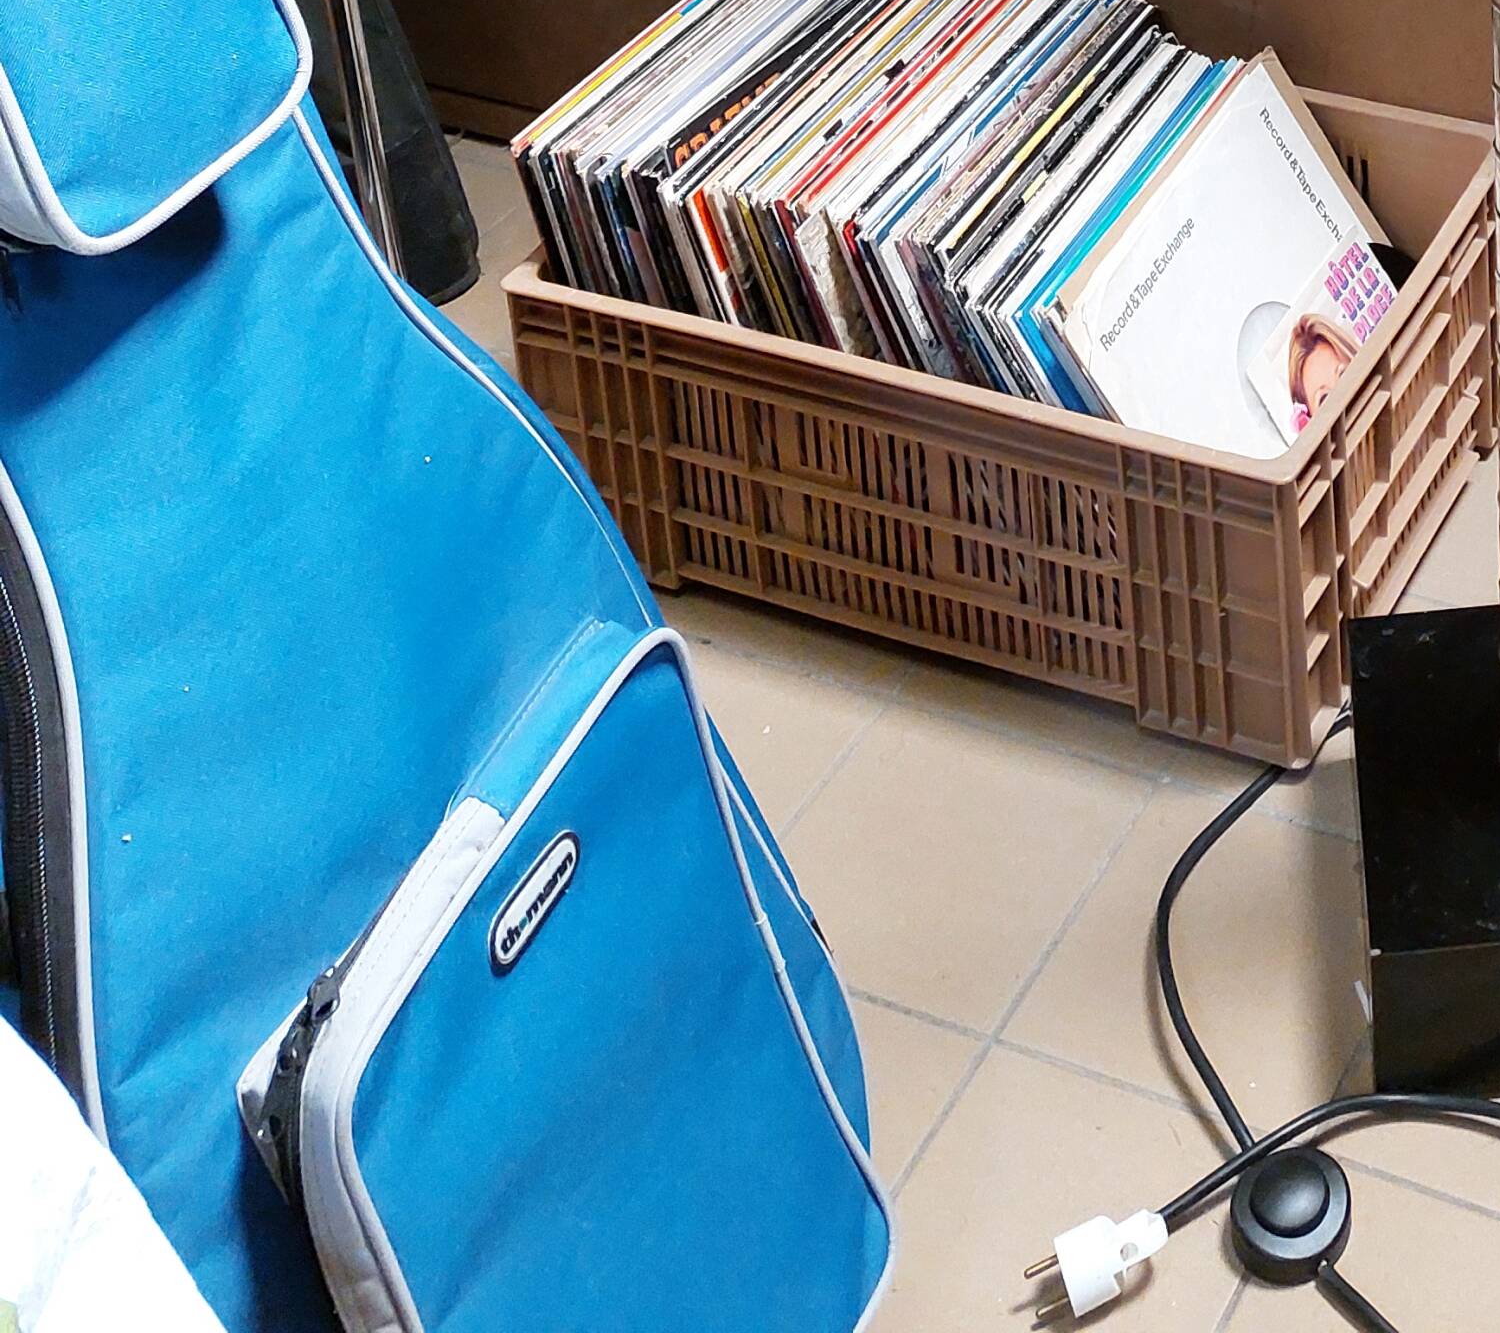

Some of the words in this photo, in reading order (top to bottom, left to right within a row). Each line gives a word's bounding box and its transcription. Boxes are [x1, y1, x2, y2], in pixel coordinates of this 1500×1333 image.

[1259, 107, 1293, 161] Record
[1296, 165, 1317, 203] Tape
[1315, 199, 1343, 243] Exch
[1099, 301, 1134, 352] Record
[1133, 270, 1158, 302] Tape
[1153, 217, 1195, 275] Exchange
[1324, 242, 1370, 302] HÔTEL
[1341, 286, 1365, 321] DE
[1356, 267, 1380, 299] LA
[501, 851, 574, 956] thomann
